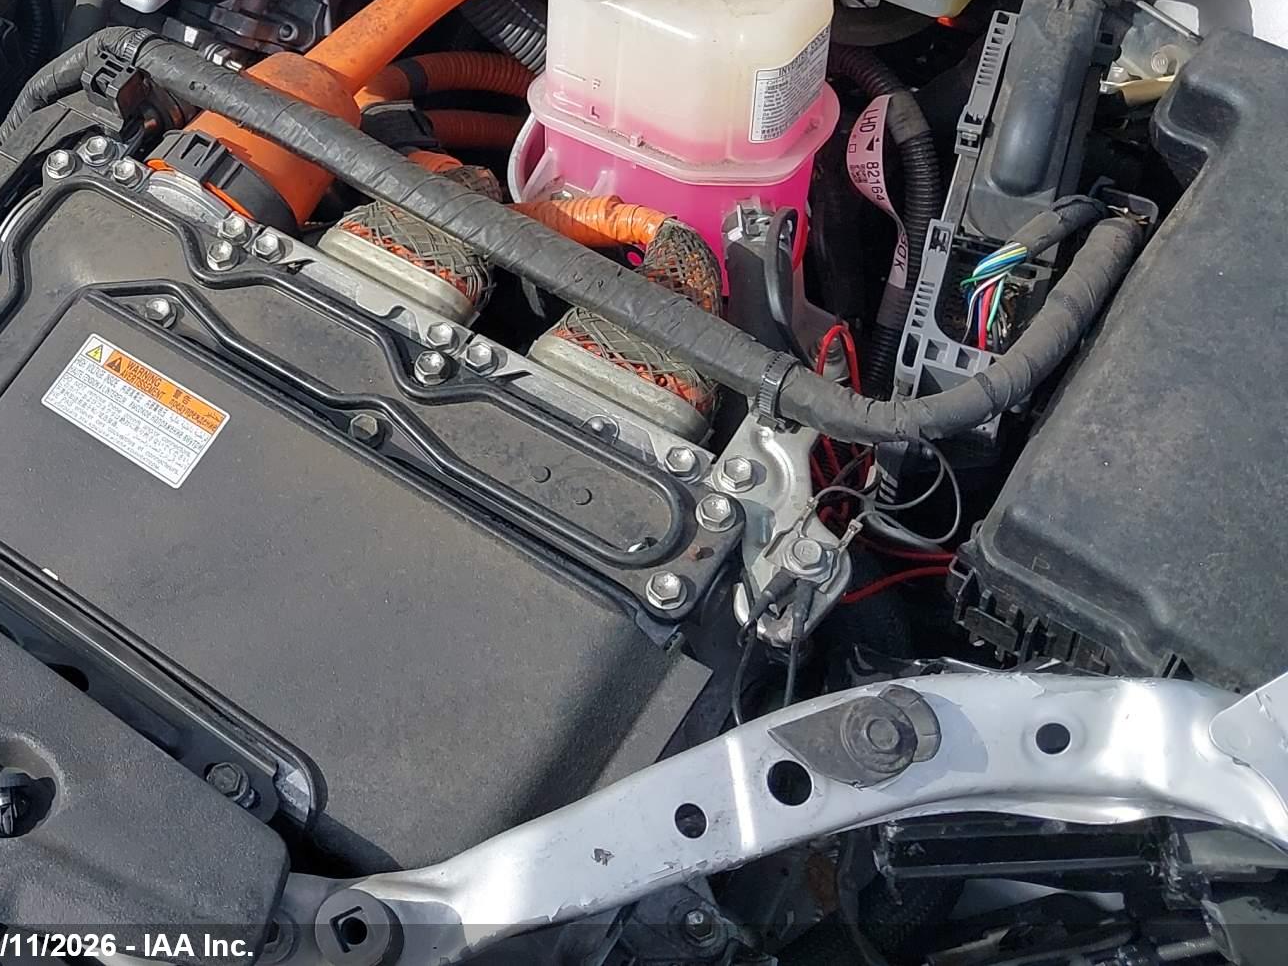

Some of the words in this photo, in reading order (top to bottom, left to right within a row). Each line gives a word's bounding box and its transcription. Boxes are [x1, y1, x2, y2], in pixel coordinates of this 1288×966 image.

[860, 108, 878, 133] LHD
[866, 161, 885, 202] 82164
[120, 369, 165, 401] AVERTISSEMENT
[126, 361, 163, 388] WARNING
